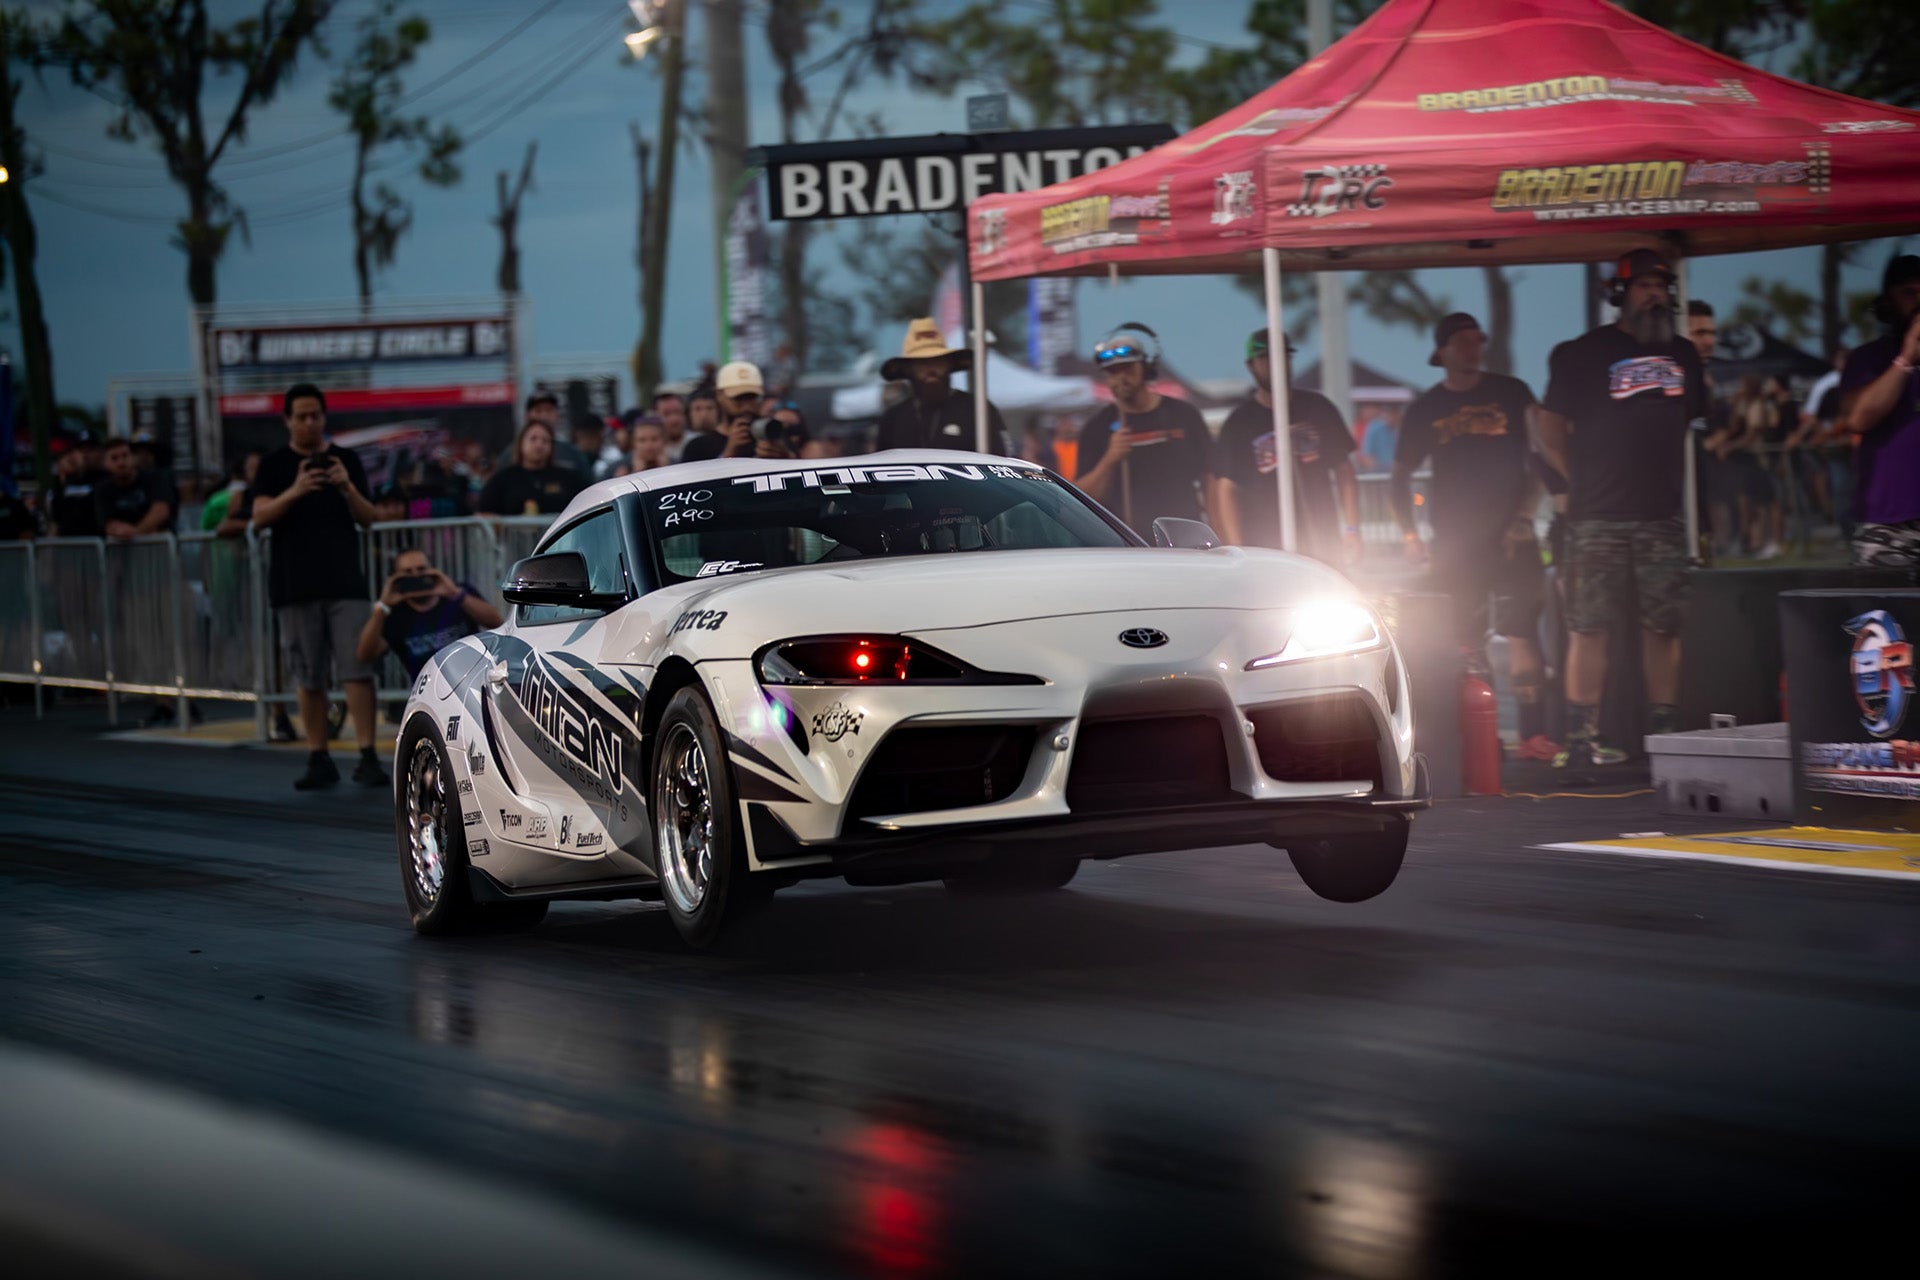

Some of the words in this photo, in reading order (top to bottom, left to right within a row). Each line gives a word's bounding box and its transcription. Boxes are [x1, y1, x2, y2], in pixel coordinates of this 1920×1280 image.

[1417, 76, 1609, 112] BRADENTON
[781, 146, 1162, 217] BRADENTO
[1491, 160, 1686, 211] BRADENTON
[1534, 200, 1761, 220] www.RACEBMP.com
[731, 464, 988, 494] TITAN
[658, 489, 714, 511] 240
[664, 508, 714, 528] A90
[534, 728, 628, 822] MOTORSPORTS
[526, 817, 547, 832] ARP
[576, 832, 603, 846] FuelTech
